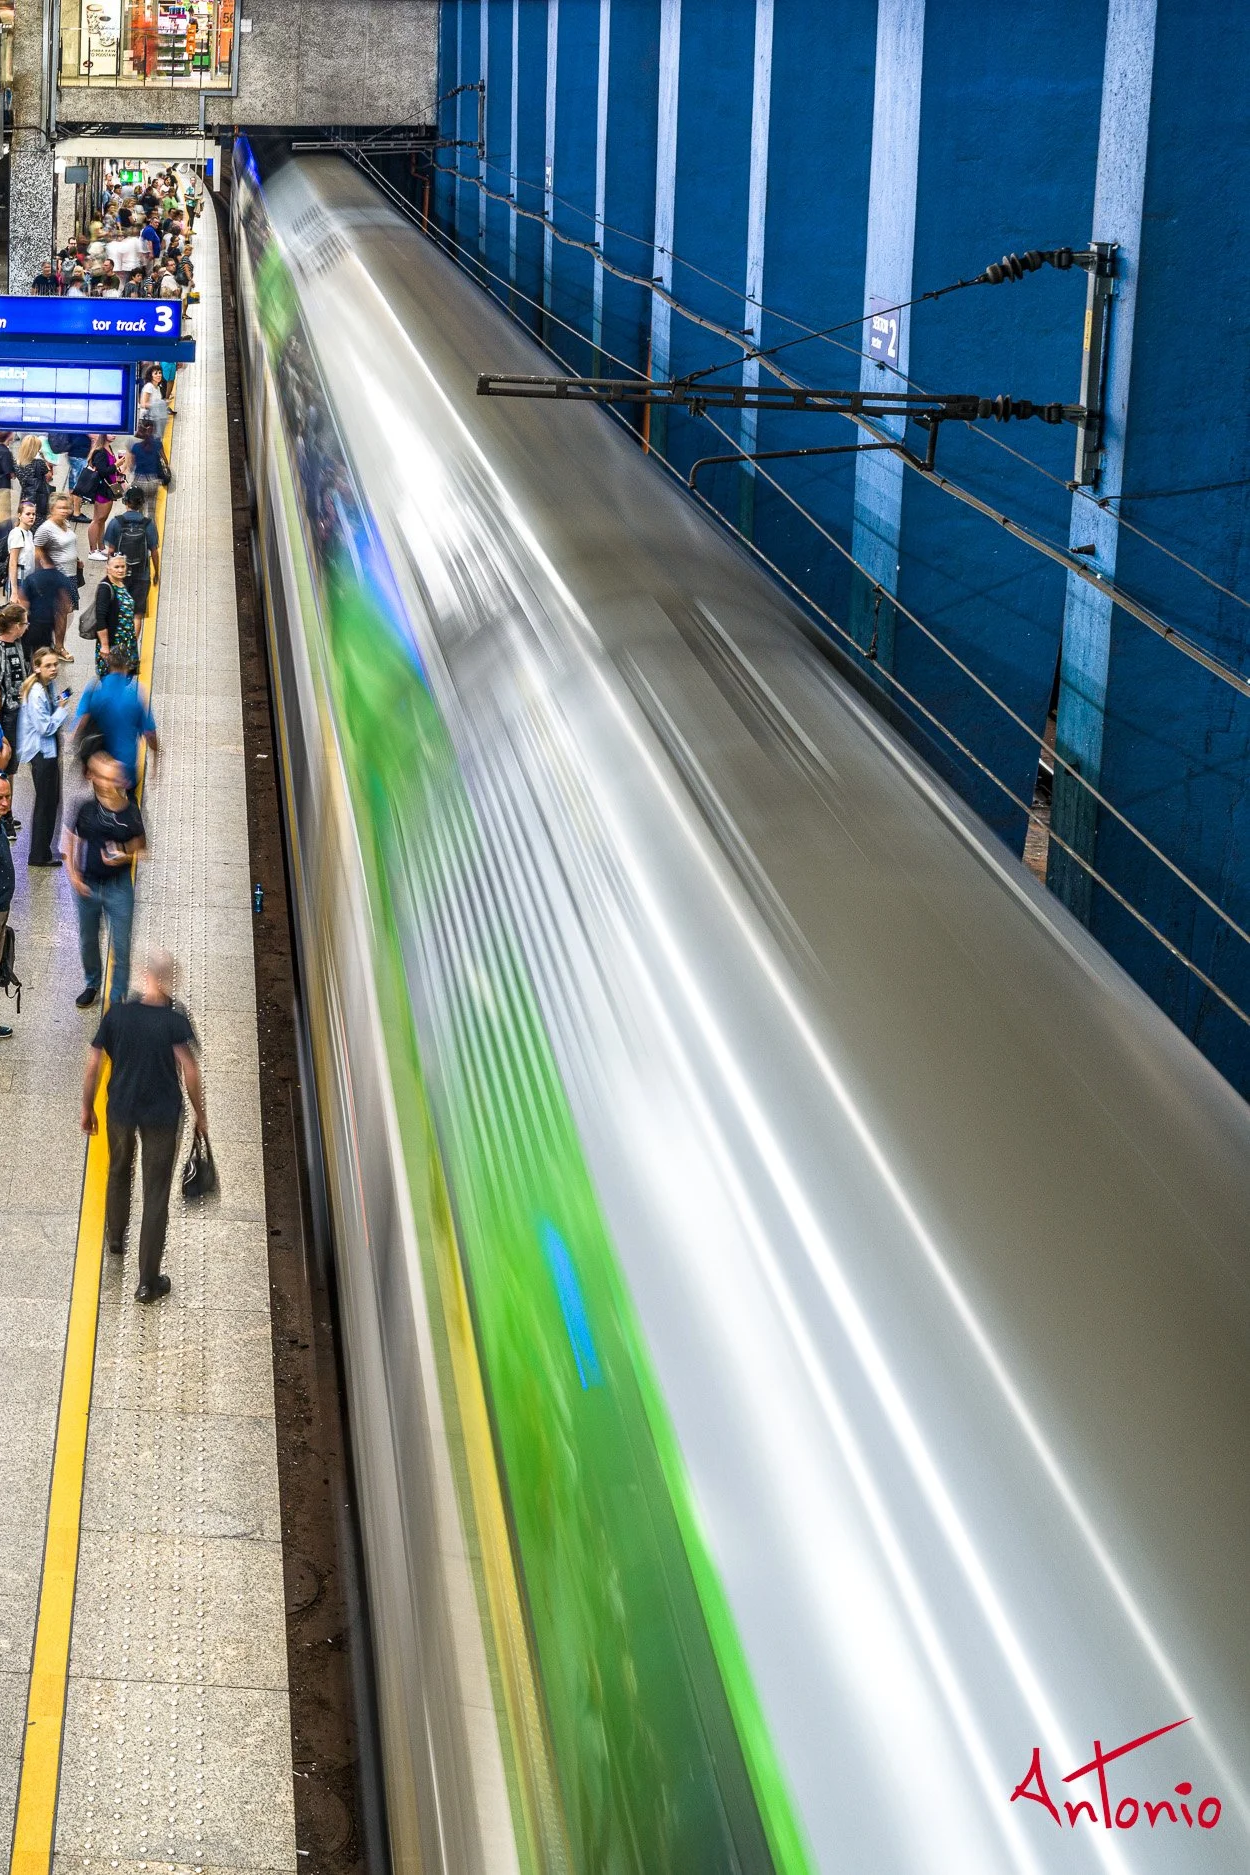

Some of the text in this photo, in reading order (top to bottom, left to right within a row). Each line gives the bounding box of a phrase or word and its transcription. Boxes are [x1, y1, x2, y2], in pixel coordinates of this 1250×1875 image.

[92, 319, 111, 331] tor
[116, 319, 146, 332] track
[154, 305, 174, 333] 3
[887, 319, 897, 358] 2
